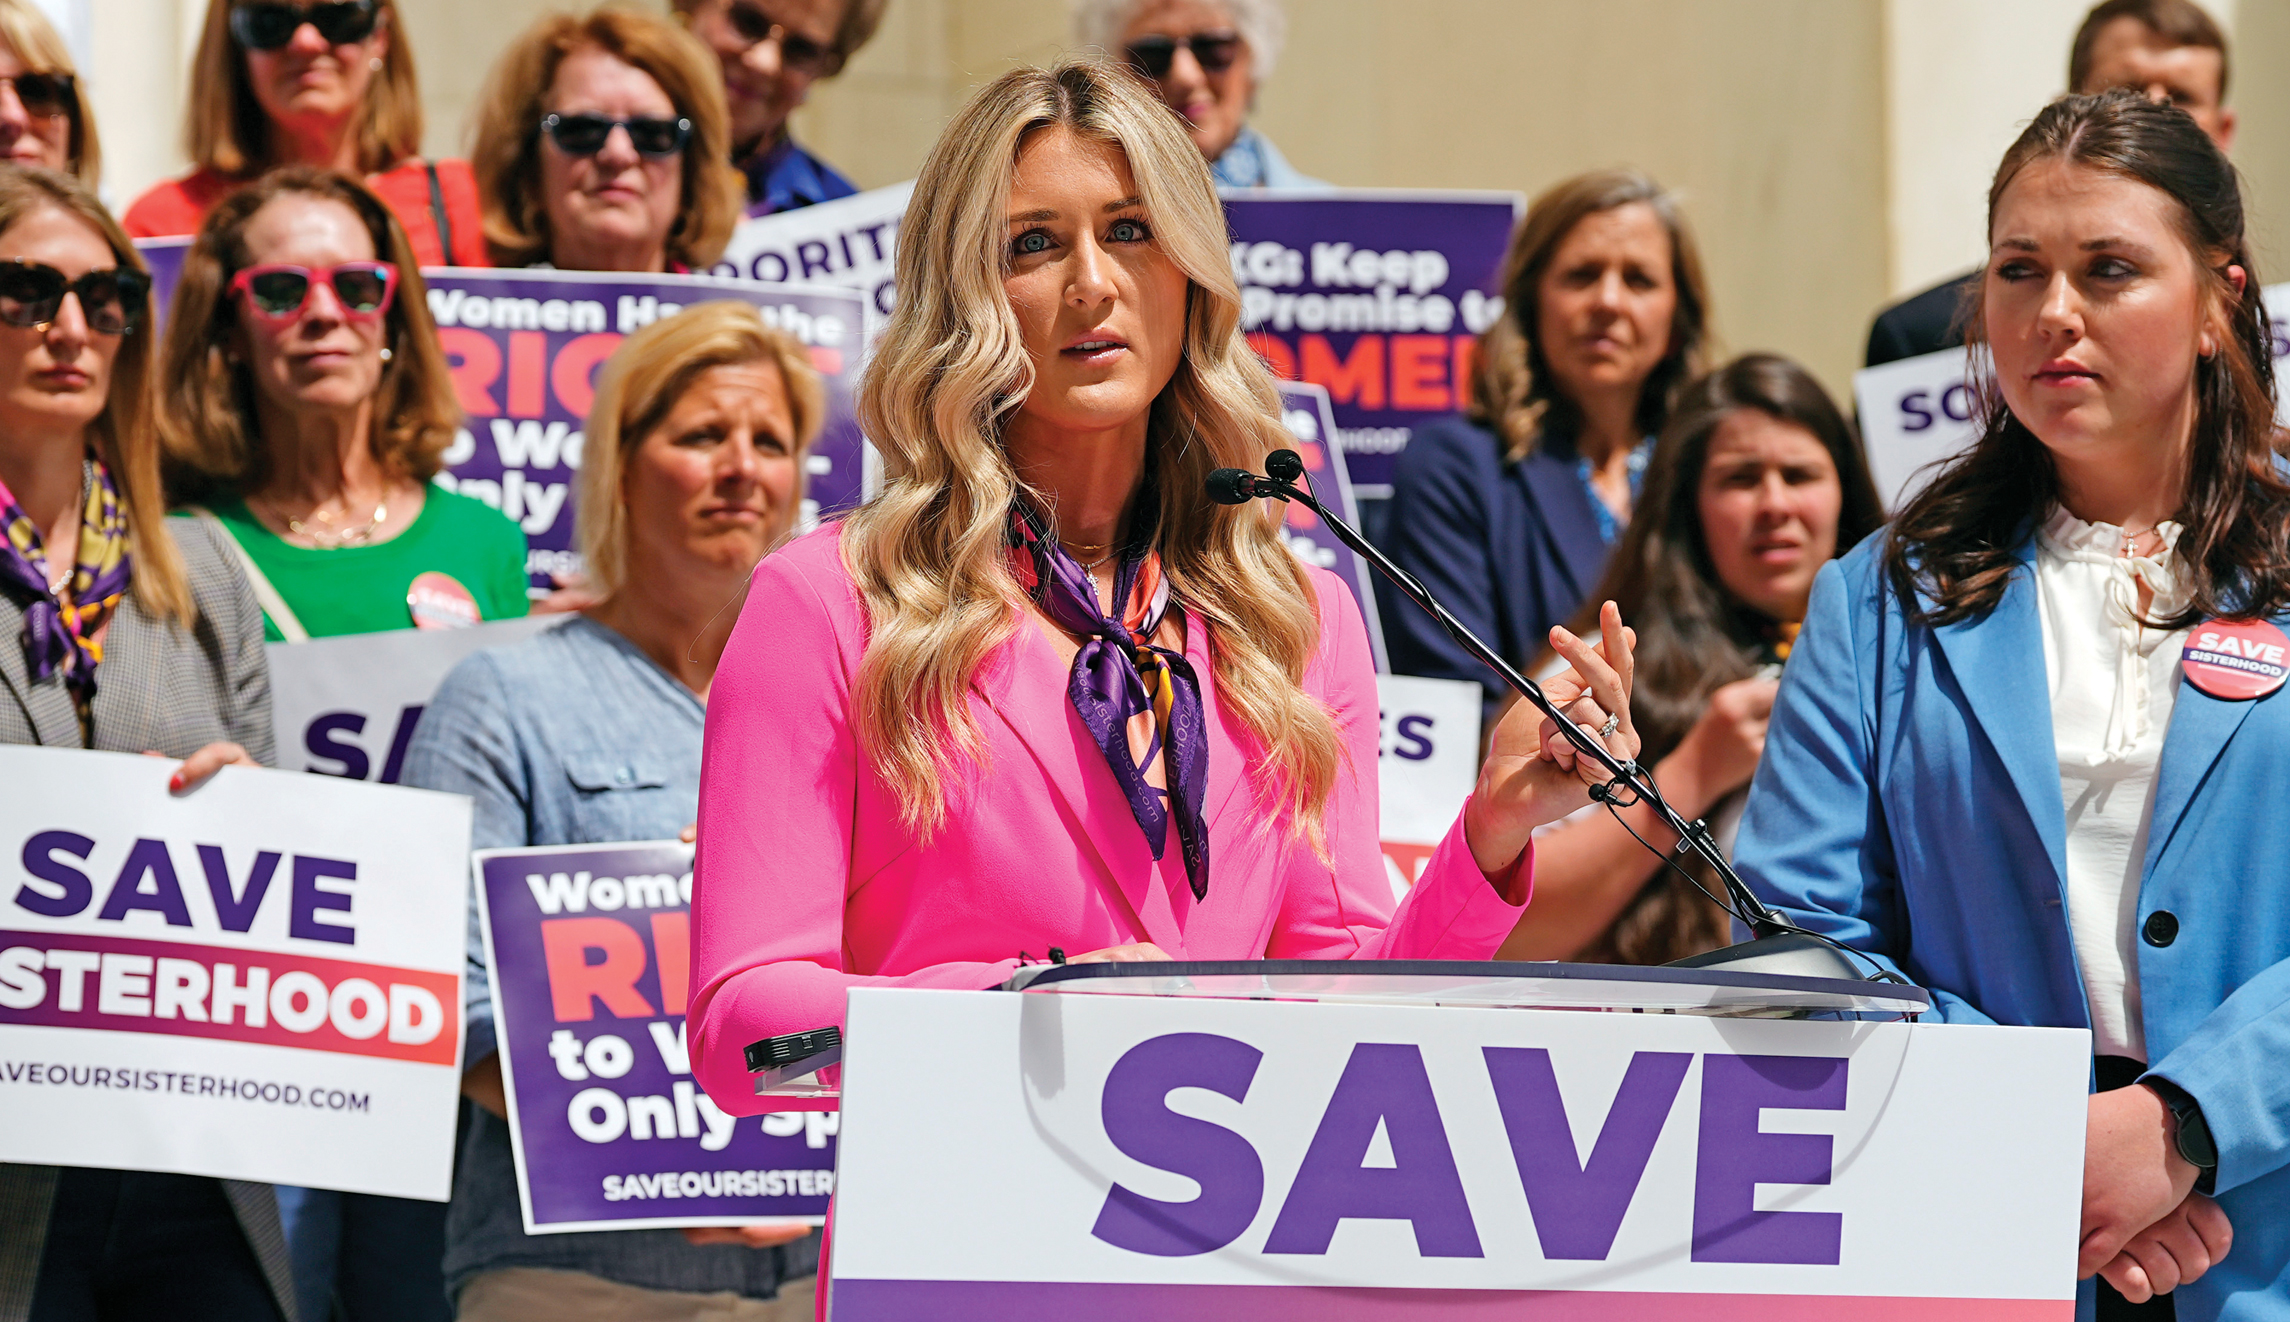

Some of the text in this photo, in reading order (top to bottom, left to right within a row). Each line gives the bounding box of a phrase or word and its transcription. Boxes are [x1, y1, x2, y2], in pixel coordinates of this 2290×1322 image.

[711, 217, 901, 282] ORIT
[1310, 241, 1449, 295] Keep
[1241, 286, 1455, 332] Promise
[1245, 333, 1476, 411] ME
[432, 468, 569, 536] nly
[2189, 650, 2282, 677] SISTERHOOD
[2197, 632, 2285, 664] SAVE
[15, 830, 357, 945] SAVE
[0, 946, 444, 1046] STERHOOD
[548, 1030, 634, 1081] to
[0, 1061, 371, 1113] VEOURSISTERHOOD.COM
[568, 1081, 738, 1151] Only
[1091, 1032, 1849, 1266] SAVE
[602, 1169, 834, 1202] SAVEOURSISTER
